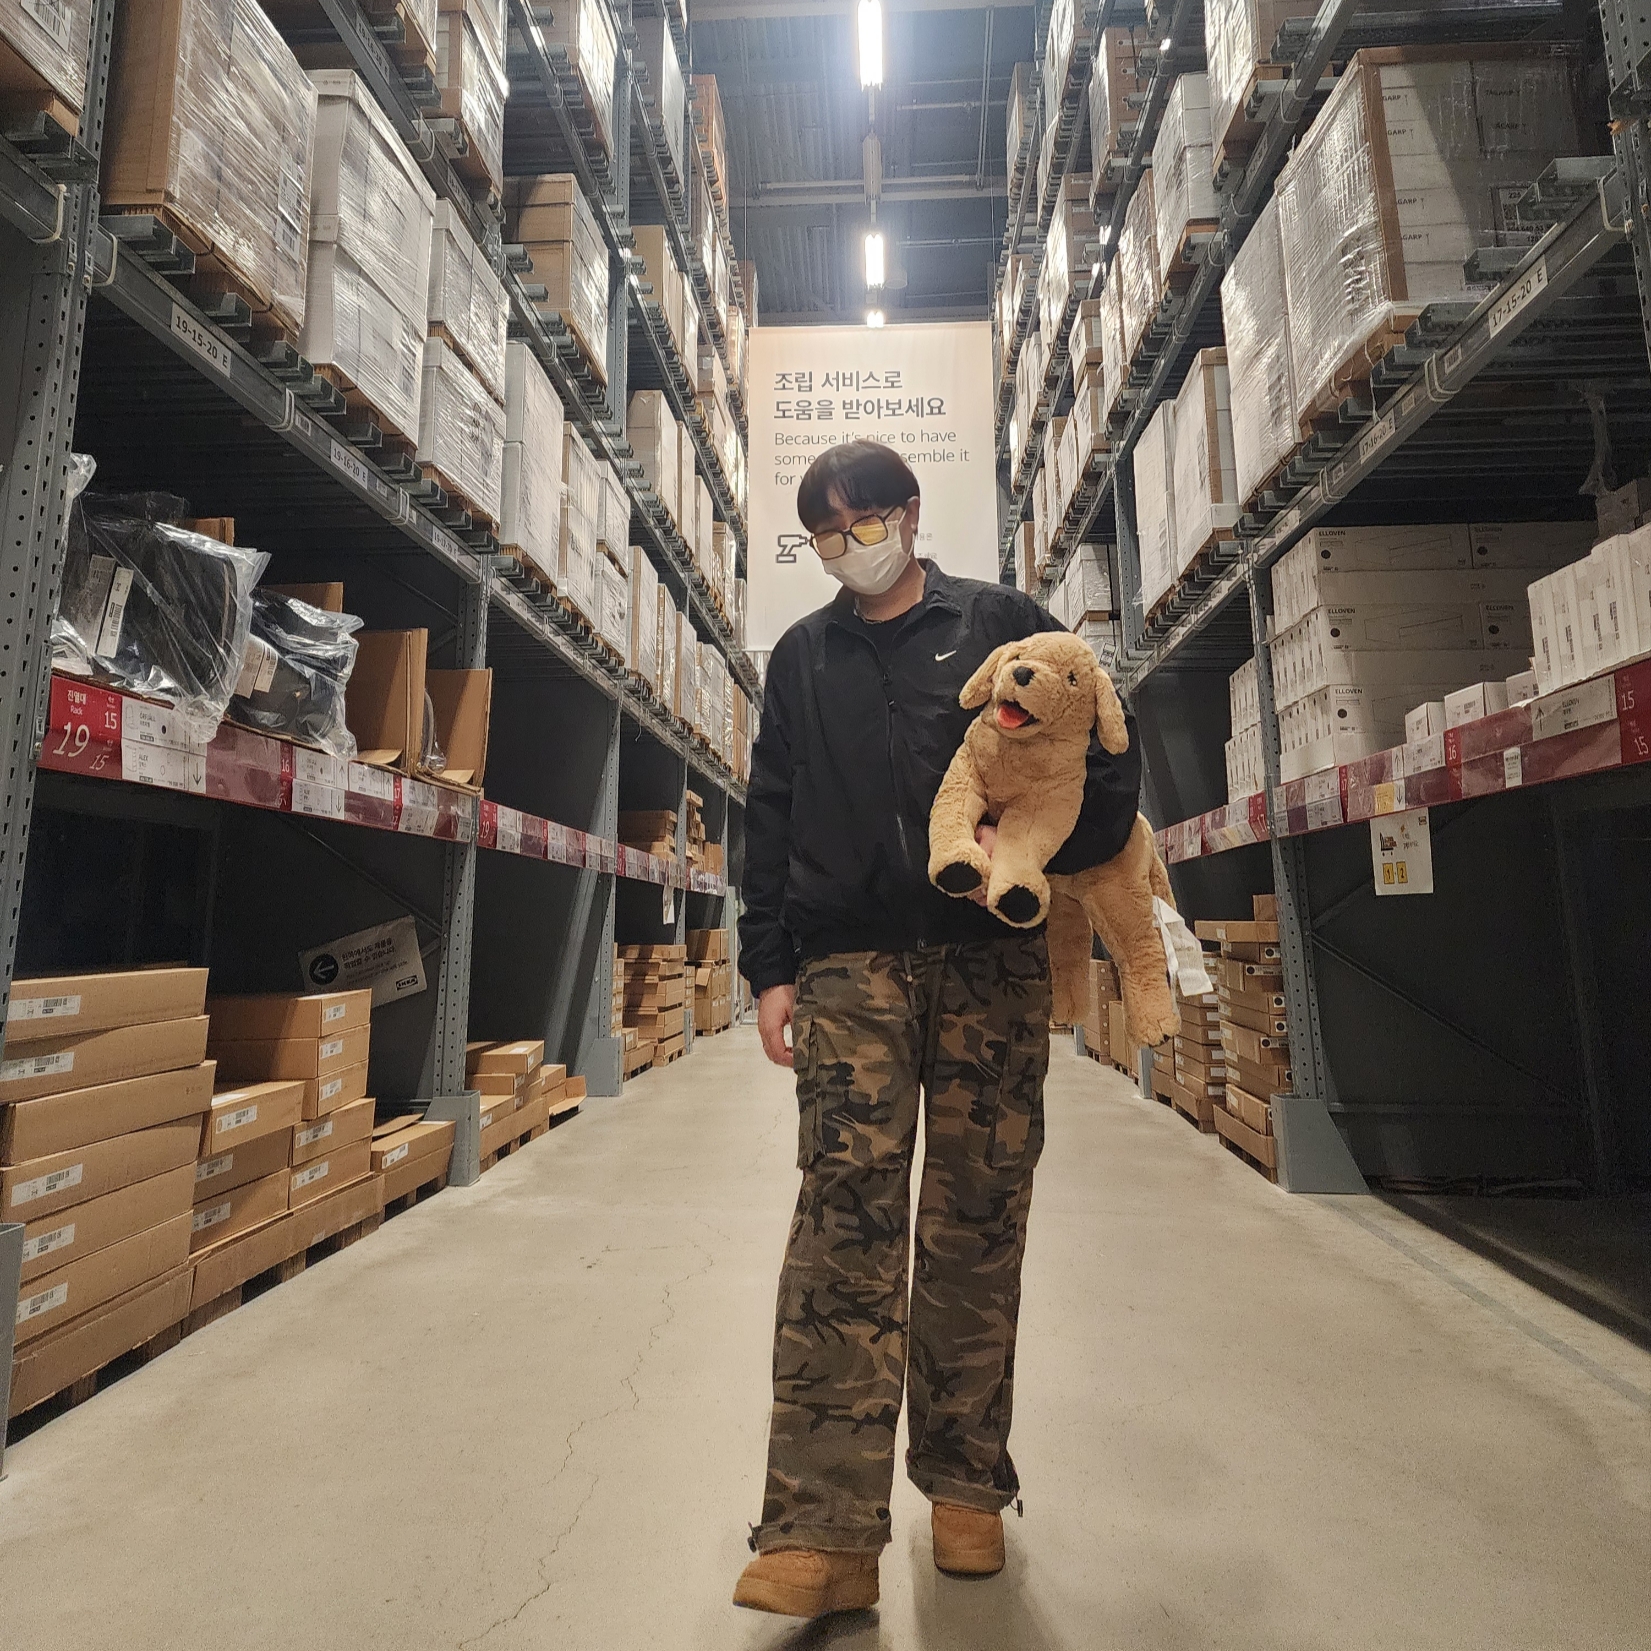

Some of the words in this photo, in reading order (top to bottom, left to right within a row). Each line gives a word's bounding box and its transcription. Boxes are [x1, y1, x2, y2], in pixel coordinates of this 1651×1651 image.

[1382, 94, 1401, 102] GARP
[1387, 128, 1407, 136] GARP
[1397, 198, 1418, 206] GARP
[1401, 233, 1422, 241] GARP
[1492, 279, 1532, 328] 17-15-20
[1536, 267, 1543, 284] E
[175, 315, 218, 359] 19-15-20
[222, 353, 228, 369] E
[774, 371, 813, 393] 조립
[821, 370, 903, 392] 서비스로
[773, 399, 836, 421] 도움을
[842, 396, 947, 420] 받아보세요
[774, 432, 837, 446] Because
[900, 431, 916, 443] to
[920, 429, 956, 442] have
[774, 455, 816, 466] some
[900, 448, 955, 463] semble
[960, 448, 970, 461] it
[774, 472, 797, 486] for
[67, 689, 87, 704] 진열대
[1620, 690, 1635, 711] 15
[70, 706, 83, 716] Rack
[104, 710, 117, 730] 15
[52, 721, 90, 758] 19
[1633, 735, 1649, 756] 15
[1448, 744, 1457, 760] 16
[89, 753, 110, 771] 15
[281, 758, 290, 773] 16
[480, 820, 490, 839] 19
[397, 977, 417, 989] IKEA
